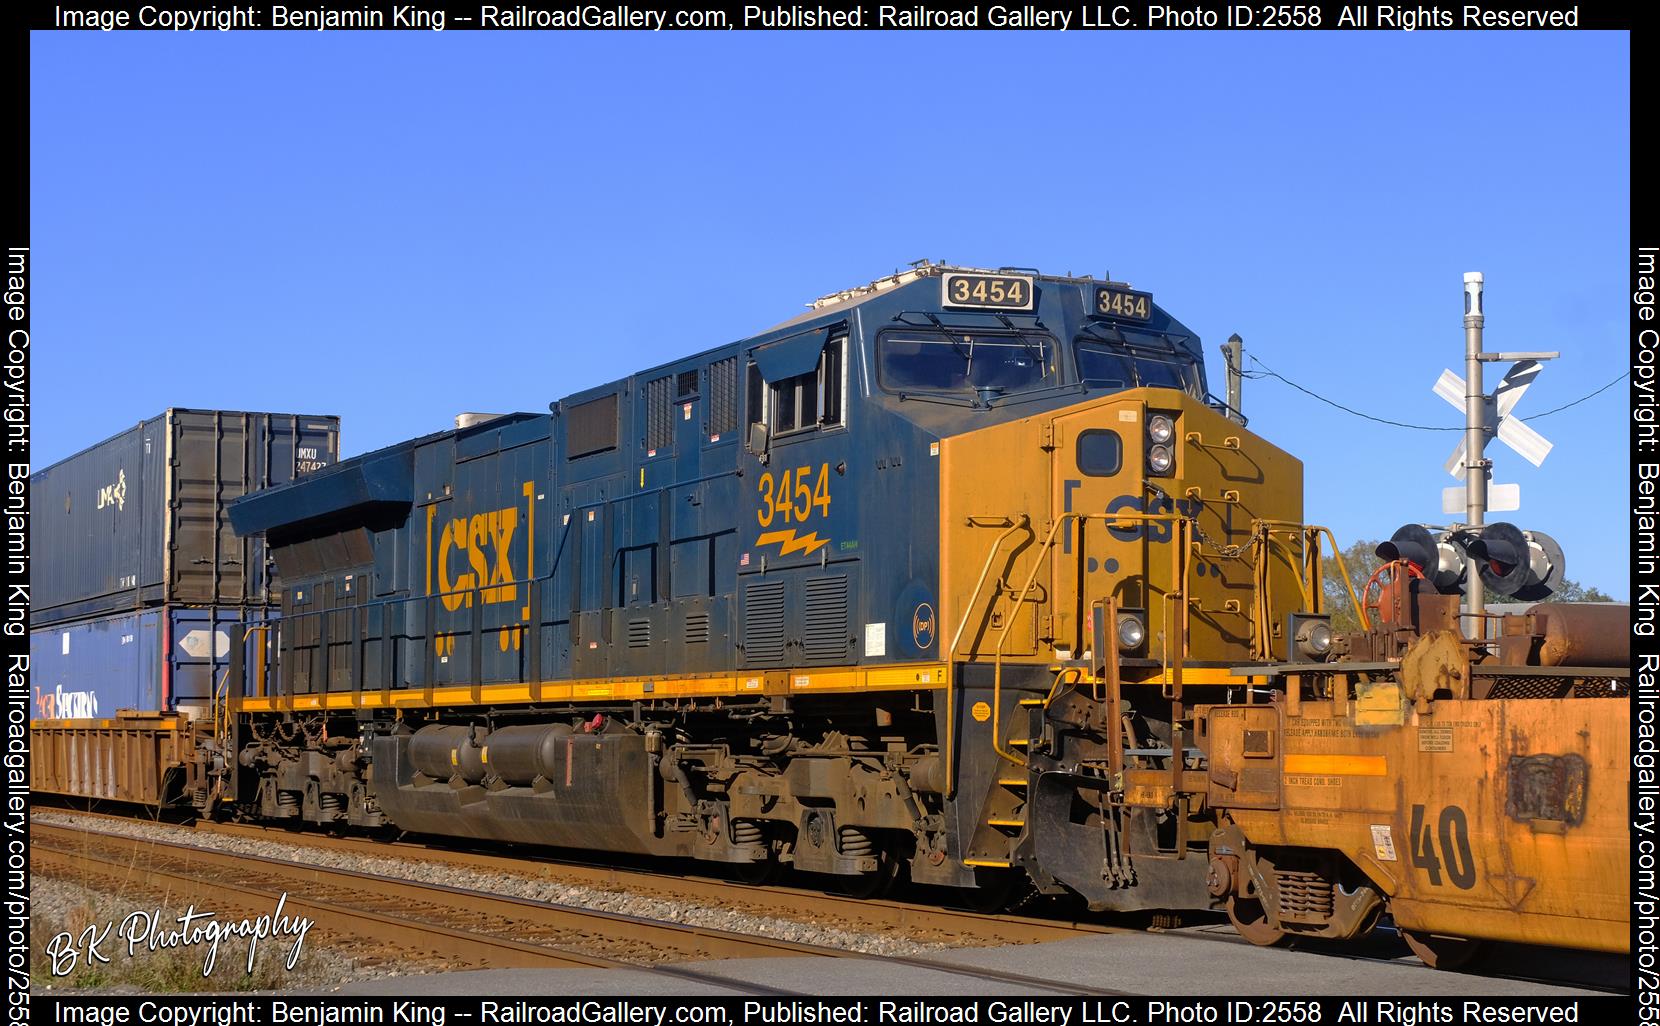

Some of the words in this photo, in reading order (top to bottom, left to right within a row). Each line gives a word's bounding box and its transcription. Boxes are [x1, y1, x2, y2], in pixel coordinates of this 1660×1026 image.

[954, 279, 1023, 303] 3454
[1099, 290, 1147, 318] 3454
[757, 463, 831, 528] 3454
[1104, 494, 1204, 543] CSX
[438, 506, 518, 612] CSX
[1409, 804, 1477, 890] 40
